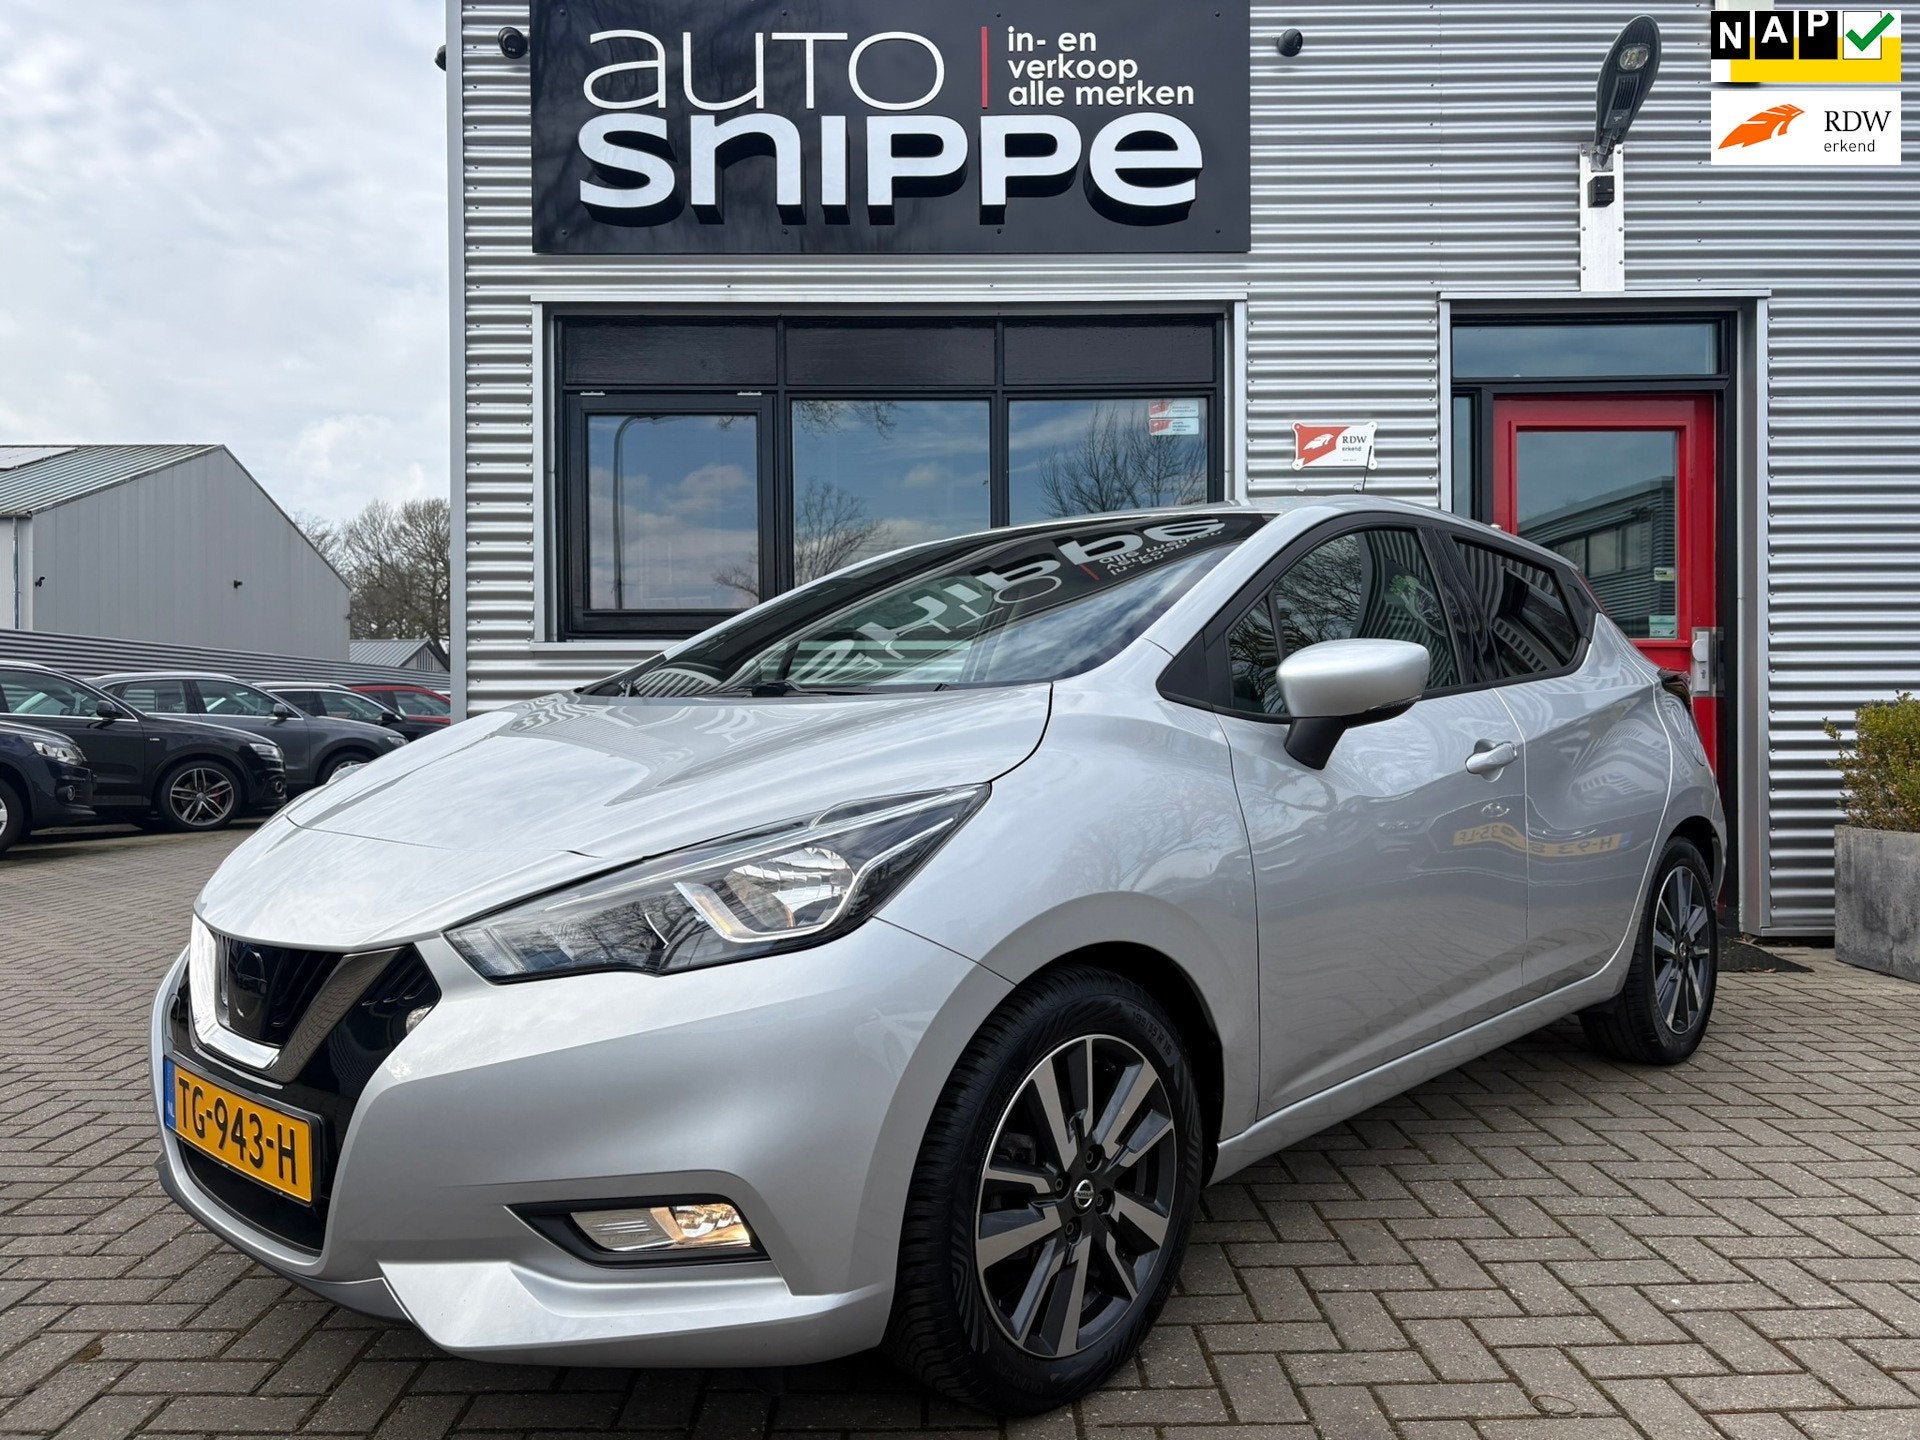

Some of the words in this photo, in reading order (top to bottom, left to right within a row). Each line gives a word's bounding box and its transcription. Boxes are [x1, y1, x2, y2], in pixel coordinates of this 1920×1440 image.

[1008, 25, 1046, 52] in-
[1058, 32, 1097, 52] en
[1007, 53, 1138, 84] verkoop
[1008, 80, 1065, 106] alle
[1076, 80, 1195, 105] merken
[1342, 435, 1367, 444] RDW
[178, 1076, 297, 1185] TG-943-H
